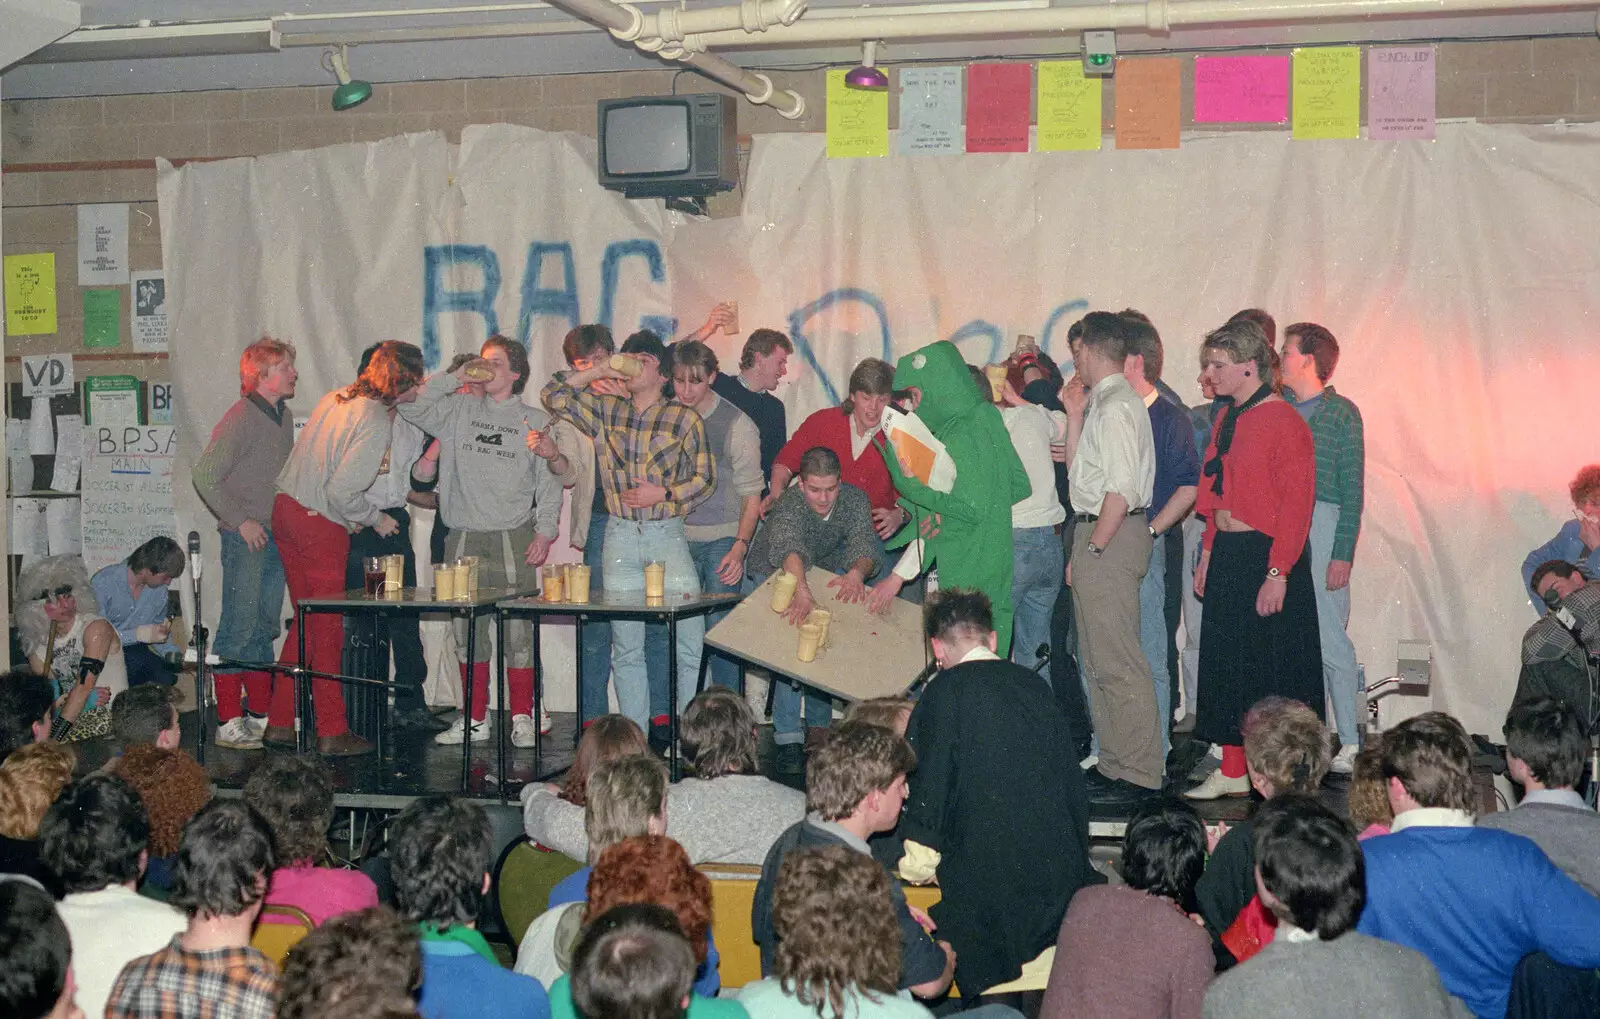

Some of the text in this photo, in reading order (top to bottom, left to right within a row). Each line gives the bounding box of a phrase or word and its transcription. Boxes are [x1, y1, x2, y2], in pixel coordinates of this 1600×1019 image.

[422, 239, 679, 370] RAG
[24, 359, 65, 387] VD
[497, 426, 520, 435] DOWN
[476, 446, 491, 455] RAG
[111, 458, 151, 471] MAIN
